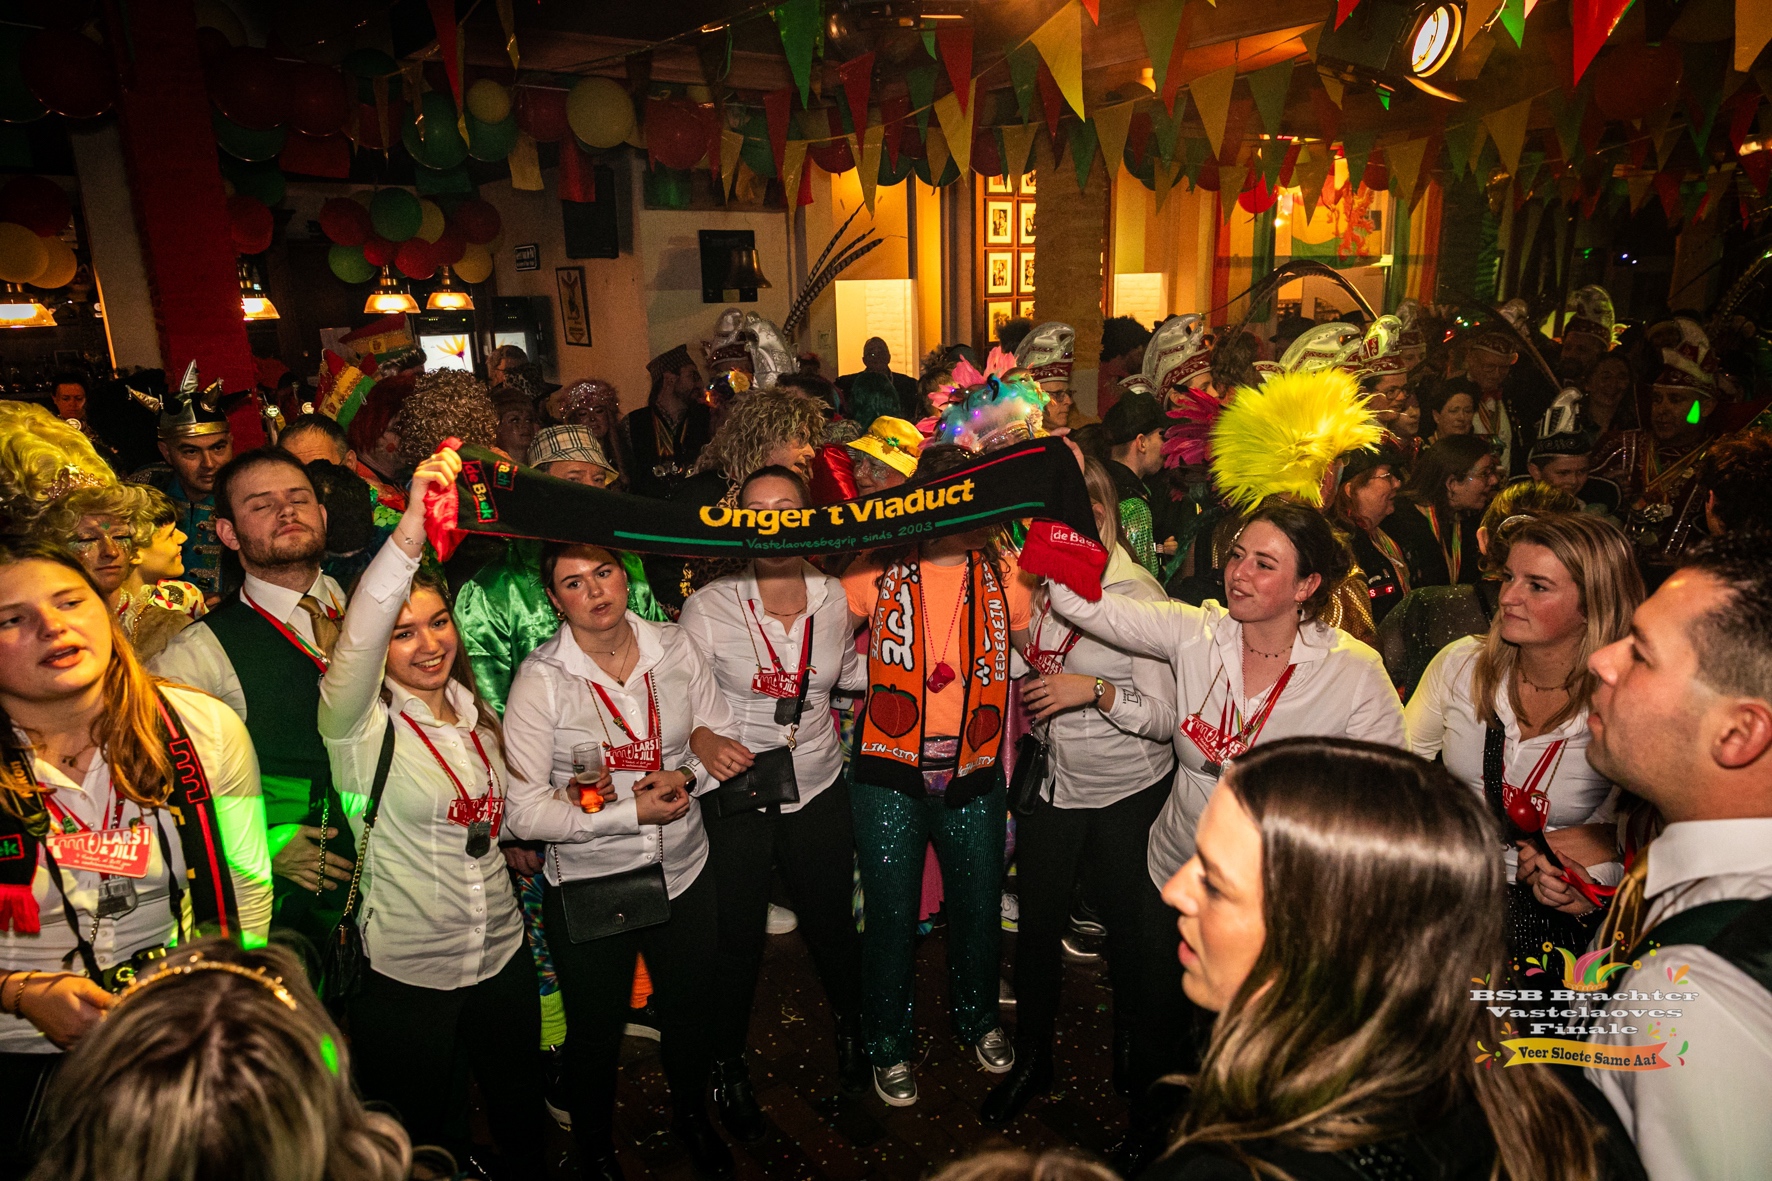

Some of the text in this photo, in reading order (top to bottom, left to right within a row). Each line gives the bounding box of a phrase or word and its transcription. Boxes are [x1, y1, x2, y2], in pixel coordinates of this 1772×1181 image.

[464, 464, 480, 483] de
[699, 506, 817, 535] Onger
[846, 478, 975, 523] Viaduct
[745, 522, 933, 549] Vastelaovesbegrip sinds 2003
[1053, 530, 1068, 541] de
[989, 599, 1006, 682] EEDEREIN
[634, 740, 655, 752] LARS
[640, 750, 655, 761] JILL
[102, 829, 141, 845] LARS
[110, 845, 138, 861] JILL
